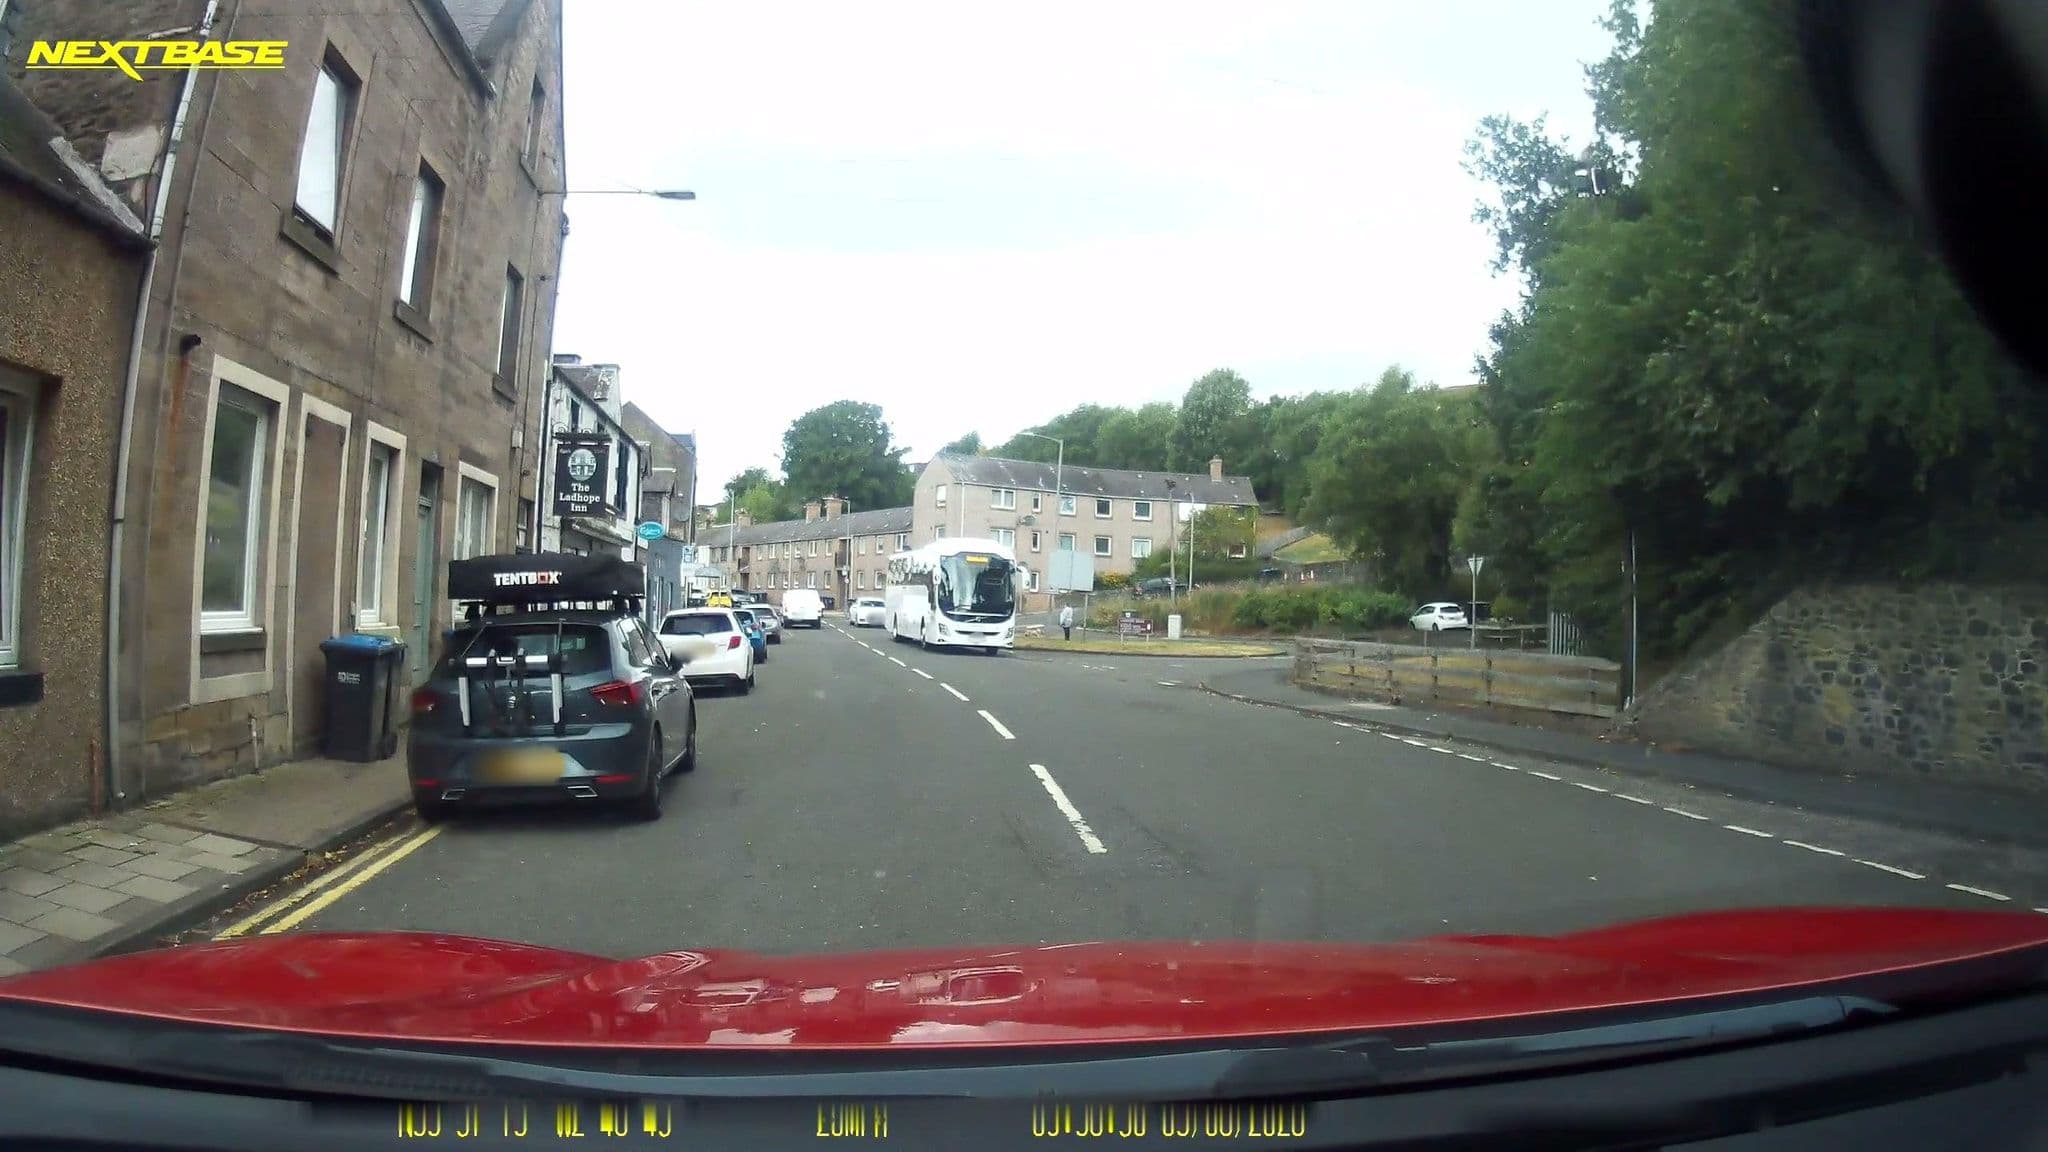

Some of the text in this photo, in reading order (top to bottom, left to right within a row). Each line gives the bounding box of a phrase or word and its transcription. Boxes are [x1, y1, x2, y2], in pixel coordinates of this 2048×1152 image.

[571, 483, 590, 492] The
[560, 492, 601, 504] Ladhope
[571, 503, 588, 512] Inn
[493, 571, 560, 586] TENTBOX
